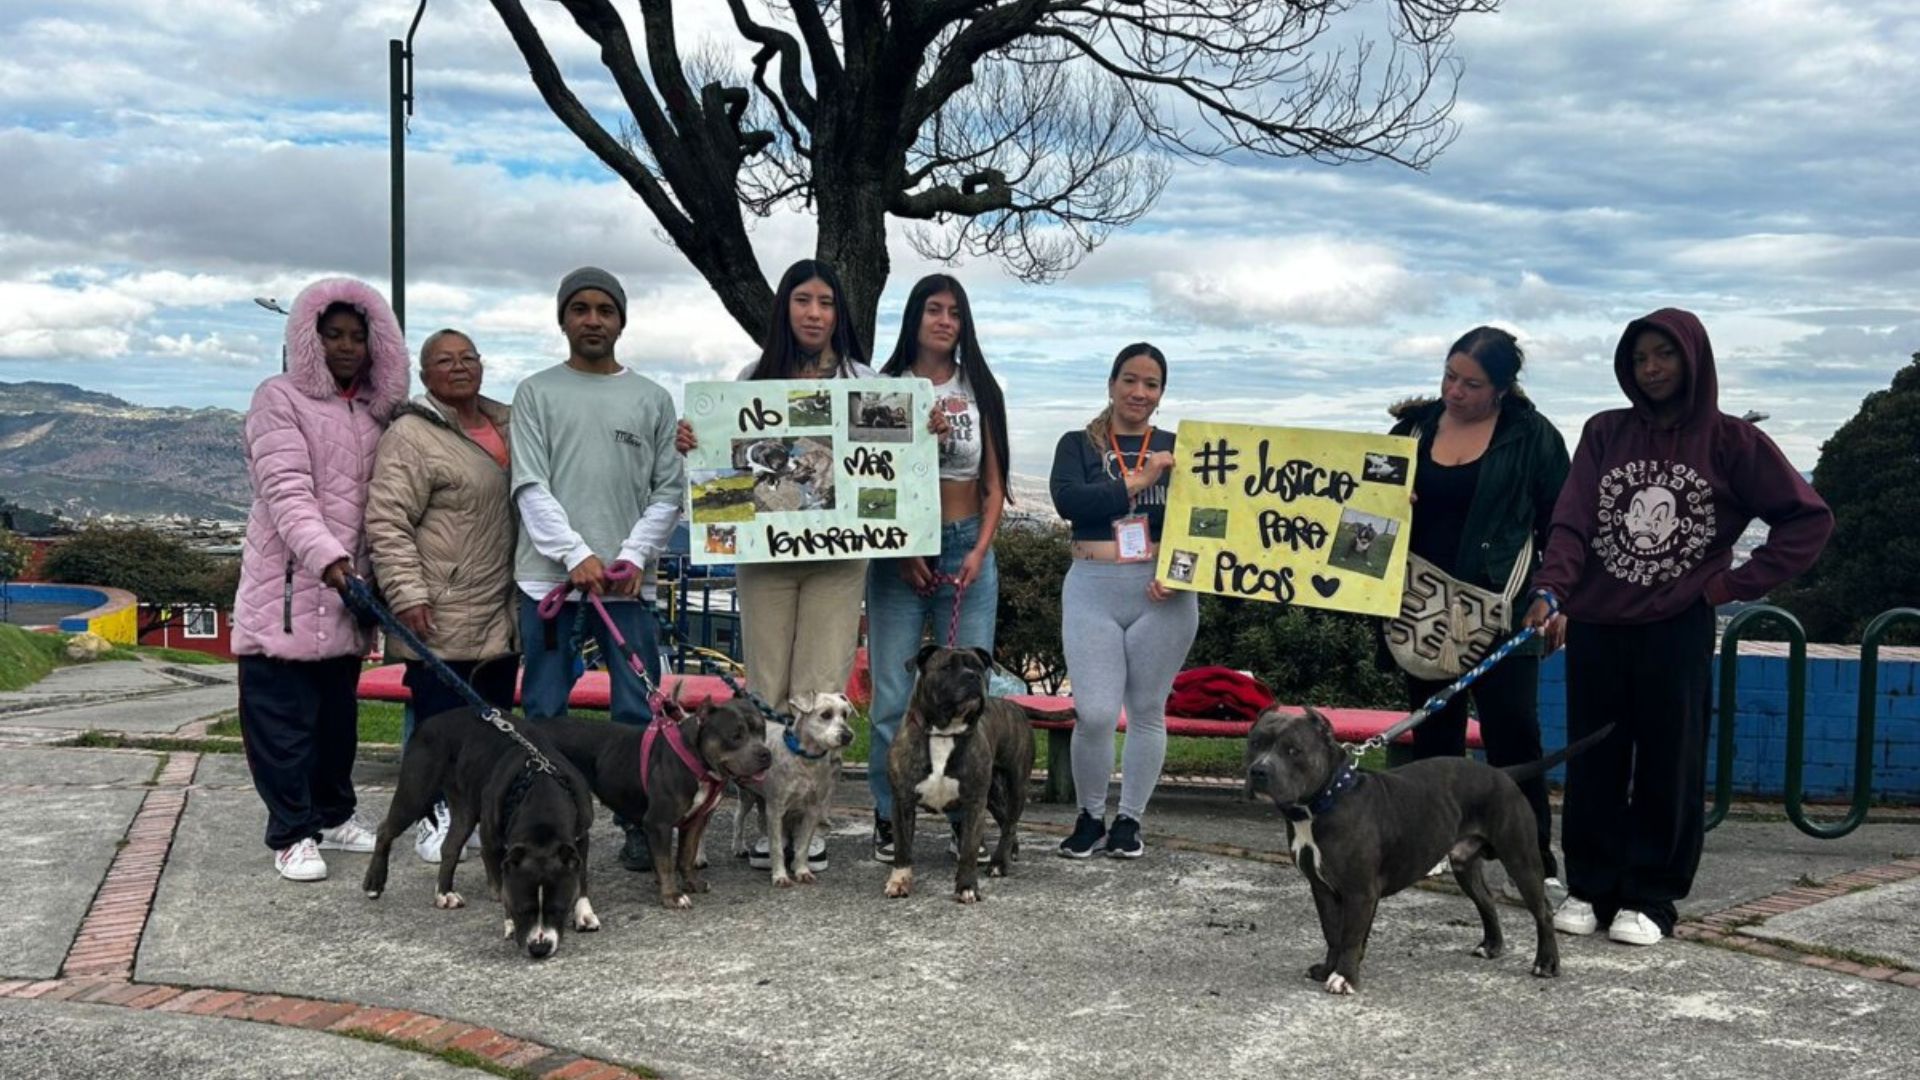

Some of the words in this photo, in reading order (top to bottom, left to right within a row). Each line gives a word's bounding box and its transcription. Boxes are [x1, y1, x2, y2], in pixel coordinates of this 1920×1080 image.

[738, 398, 783, 432] NO
[765, 523, 908, 557] IGNORANCIA
[1258, 509, 1329, 551] PARA
[1214, 550, 1296, 603] PICOS
